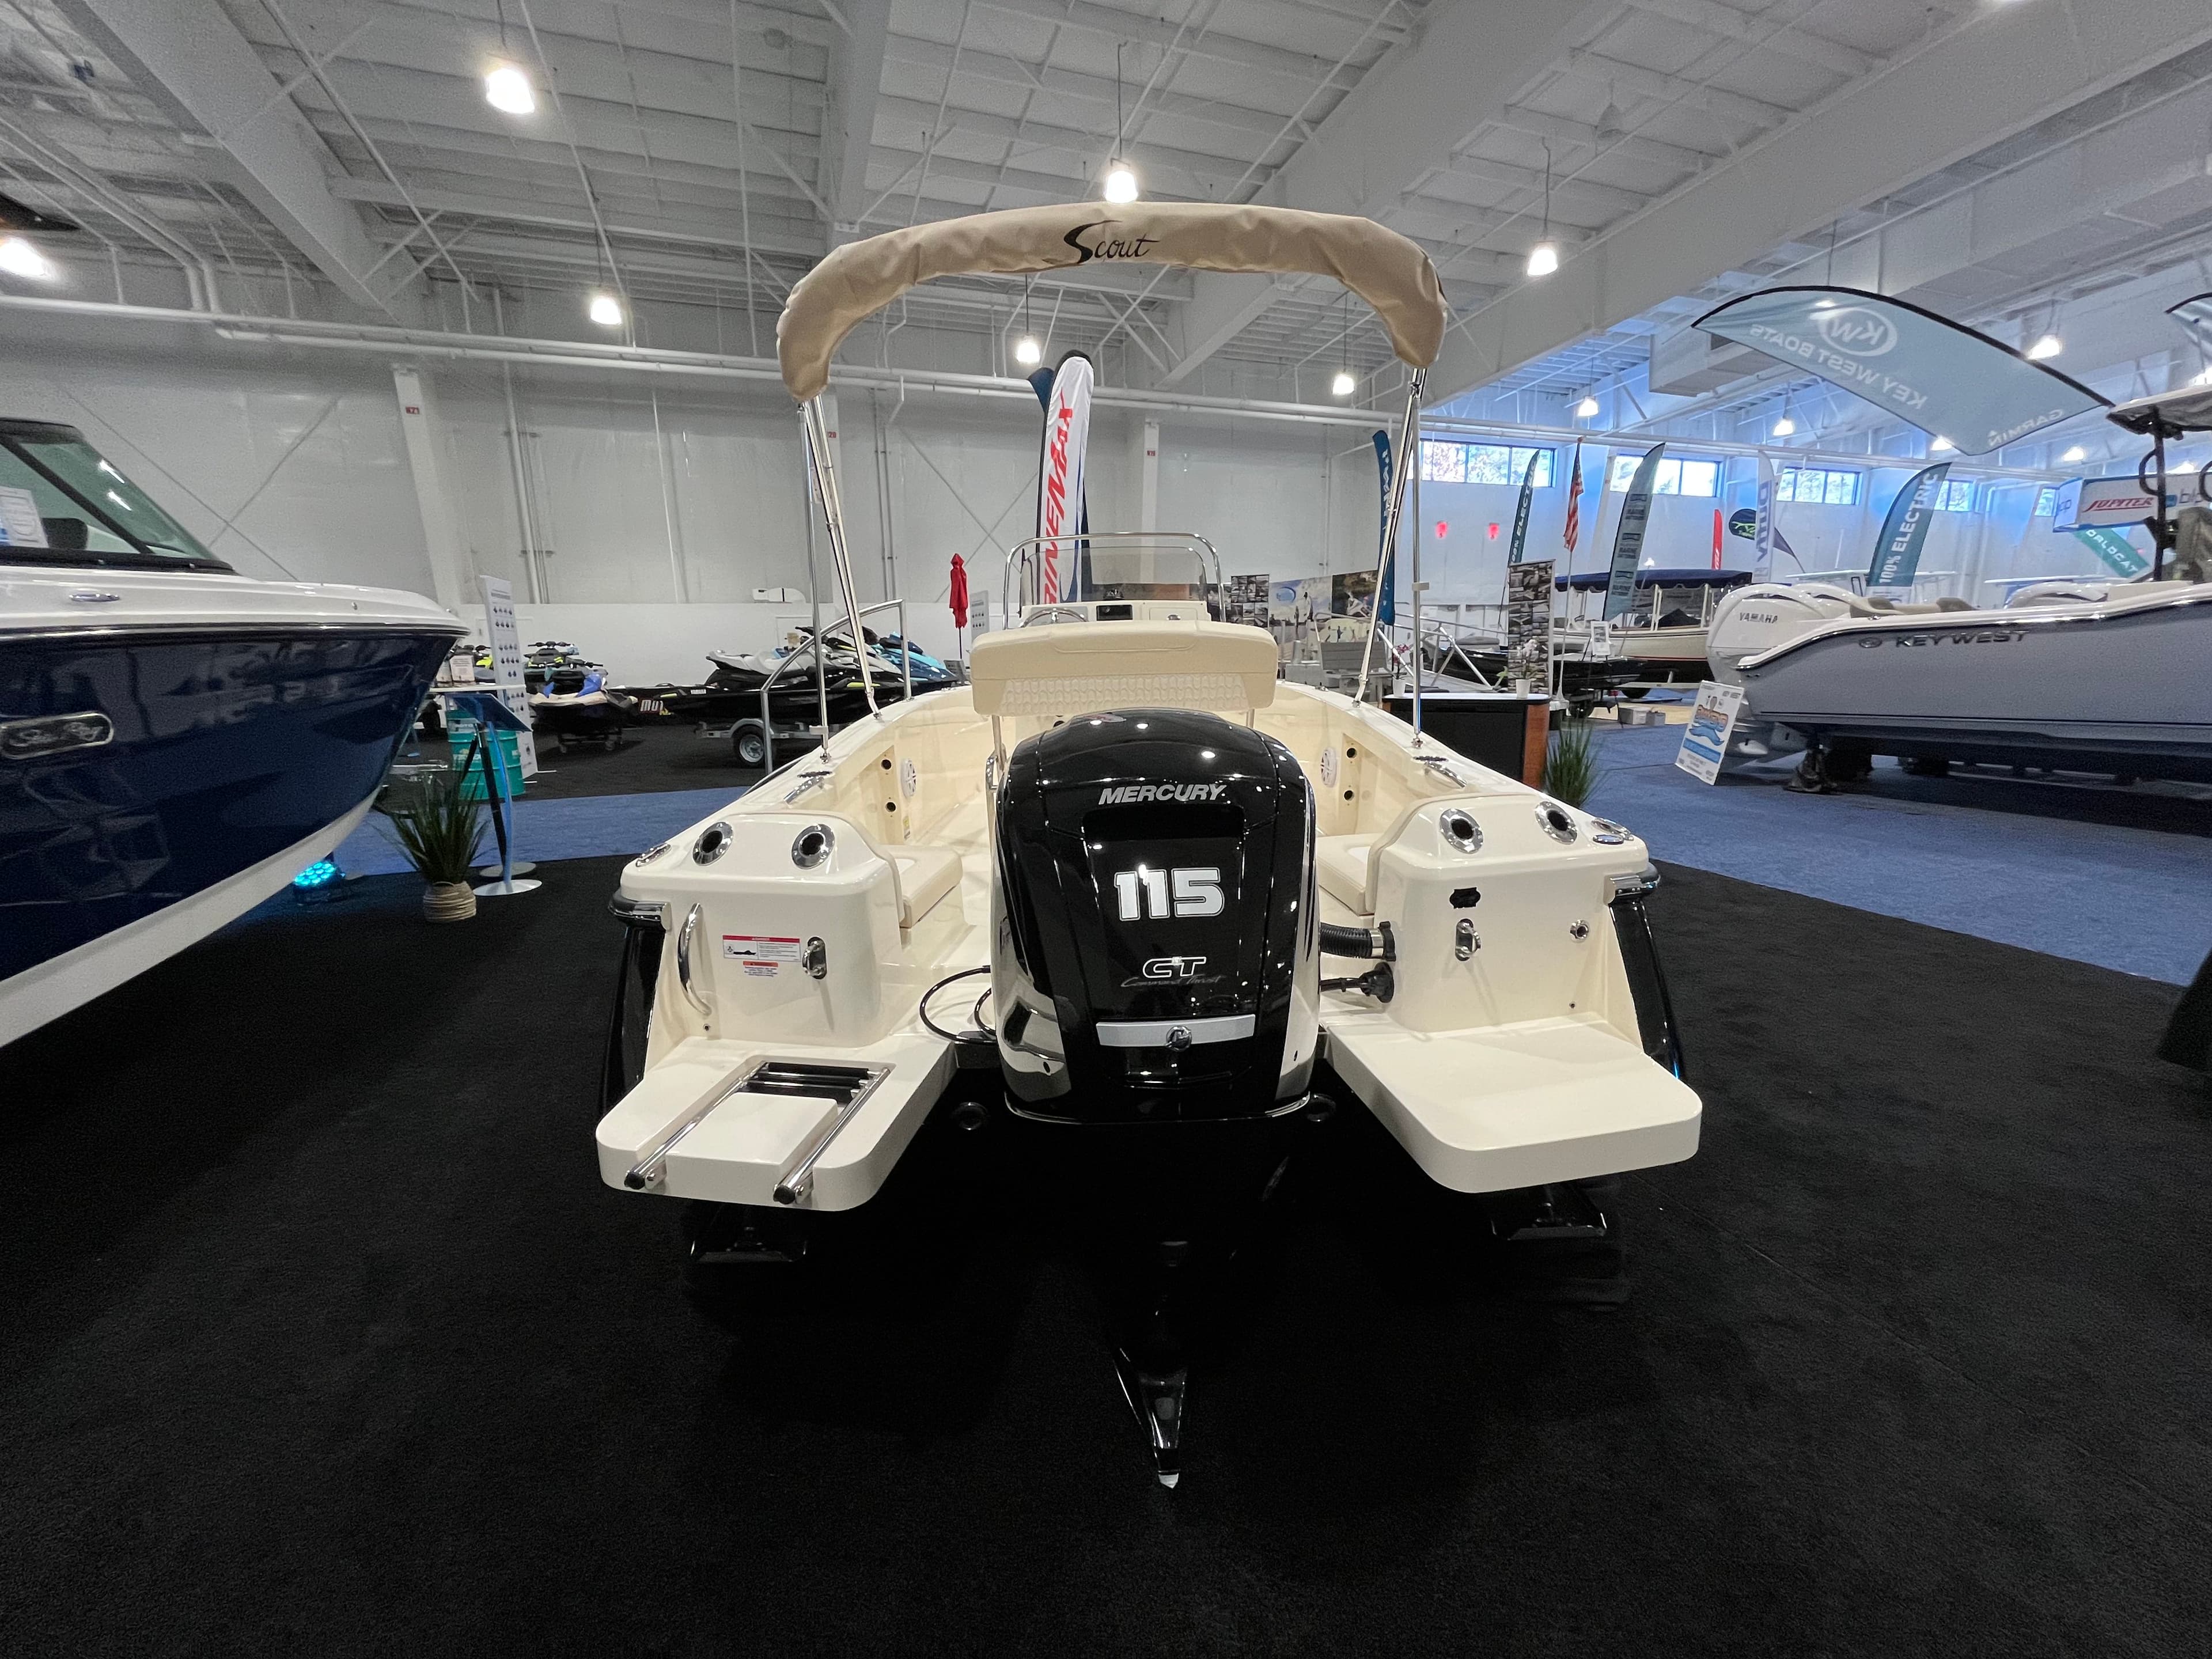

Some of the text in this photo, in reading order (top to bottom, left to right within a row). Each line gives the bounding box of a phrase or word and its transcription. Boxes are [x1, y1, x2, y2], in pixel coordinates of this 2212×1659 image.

[1063, 220, 1160, 264] Scout
[2082, 497, 2154, 513] JUPITER
[1879, 555, 1902, 584] 100%
[1891, 472, 1938, 553] ELECTRIC
[2085, 528, 2139, 573] ORLDCAT
[1740, 612, 1778, 623] YAMAHA
[1896, 635, 1946, 648] KEY
[1952, 630, 2030, 645] WEST
[1098, 784, 1227, 805] MERCURY
[1114, 866, 1225, 922] 115
